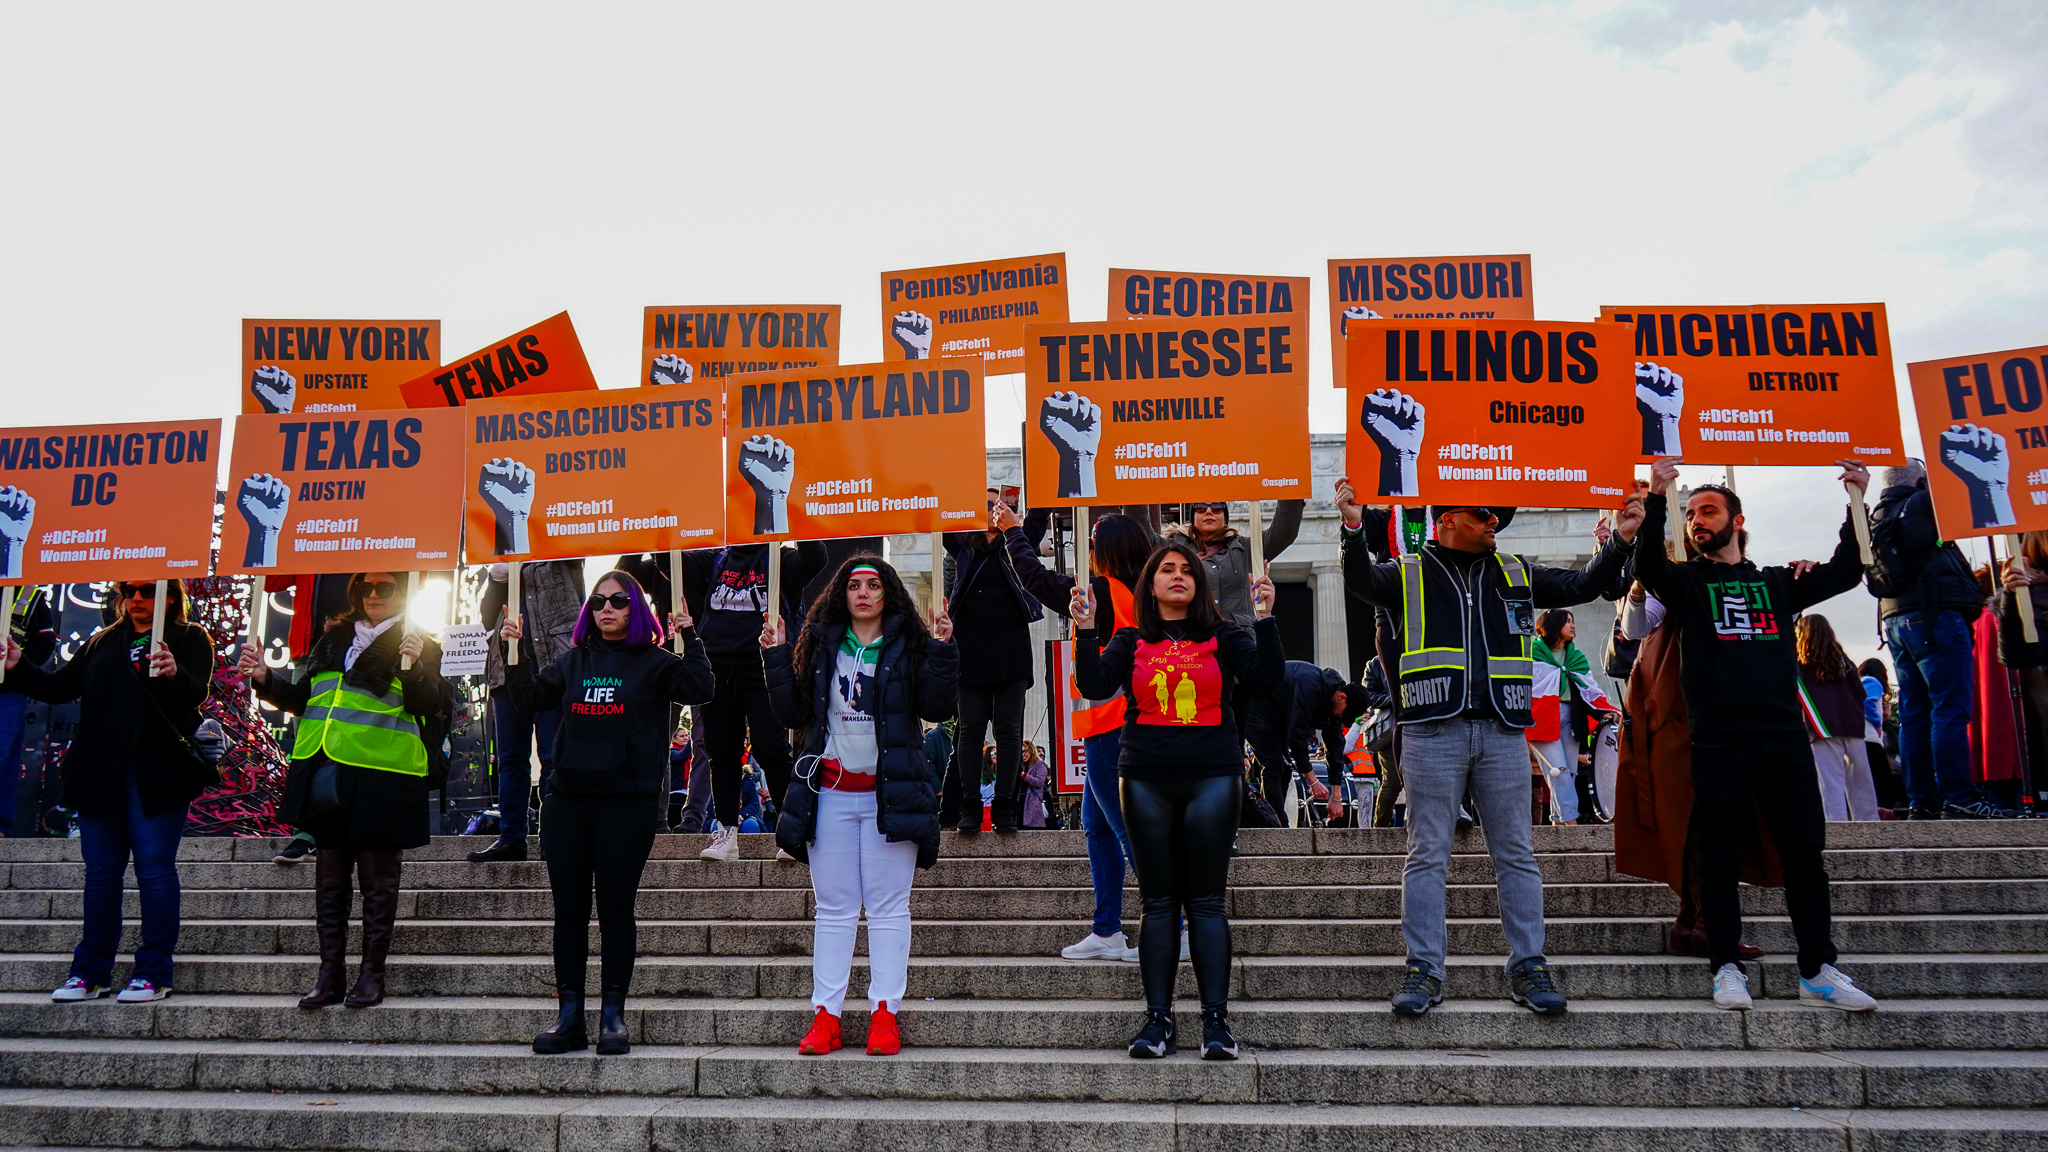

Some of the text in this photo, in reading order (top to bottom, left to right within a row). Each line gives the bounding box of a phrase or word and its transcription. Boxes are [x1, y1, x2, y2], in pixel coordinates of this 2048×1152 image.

[889, 263, 1059, 302] Pennsylvania
[1338, 261, 1523, 302] MISSOURI
[1125, 275, 1293, 317] GEORGIA
[939, 301, 1039, 325] PHILADELPHIA
[654, 312, 829, 349] NEW YORK
[1614, 311, 1879, 357] MICHIGAN
[254, 327, 430, 361] NEW YORK
[941, 337, 990, 352] #DCFeb11
[979, 350, 996, 361] ife
[997, 347, 1025, 360] Freed
[1039, 326, 1293, 383] TENNESSEE
[1385, 330, 1598, 384] ILLINOIS
[433, 334, 549, 407] TEXAS
[700, 362, 735, 378] NEW
[304, 374, 368, 390] UPSTATE
[1748, 371, 1840, 392] DETROIT
[1942, 355, 2048, 421] FLO
[304, 403, 357, 413] #DCFeb11
[741, 369, 972, 429] MARYLAND
[1112, 397, 1225, 423] NASHVILLE
[1489, 400, 1584, 427] Chicago
[1698, 408, 1774, 424] #DCFeb11
[475, 398, 713, 444] MASSACHUSETTS
[279, 418, 423, 471] TEXAS
[1700, 427, 1850, 443] Woman Life Freedom
[0, 430, 209, 470] WASHINGTON
[1114, 441, 1187, 460] #DCFeb11
[1438, 444, 1513, 461] #DCFeb11
[545, 448, 626, 474] BOSTON
[1115, 461, 1259, 480] Woman Life Freedom
[1438, 466, 1588, 482] Woman Life Freedom
[71, 472, 118, 507] DC
[298, 480, 366, 501] AUSTIN
[805, 478, 873, 497] #DCFeb11
[545, 499, 614, 518] #DCFeb11
[805, 495, 939, 517] Woman Life Freedom
[296, 518, 359, 535] #DCFeb11
[546, 514, 678, 537] Woman Life Freedom
[42, 528, 107, 546] #DCFeb11
[294, 535, 416, 552] Woman Life Freedom
[40, 545, 166, 563] Woman Life Freedom
[450, 631, 488, 639] WOMAN
[459, 640, 477, 648] LIFE
[446, 649, 488, 657] FREEDOM
[583, 676, 622, 687] WOMAN
[584, 687, 615, 703] LIFE
[1400, 676, 1452, 709] SECURITY
[571, 702, 624, 715] FREEDOM
